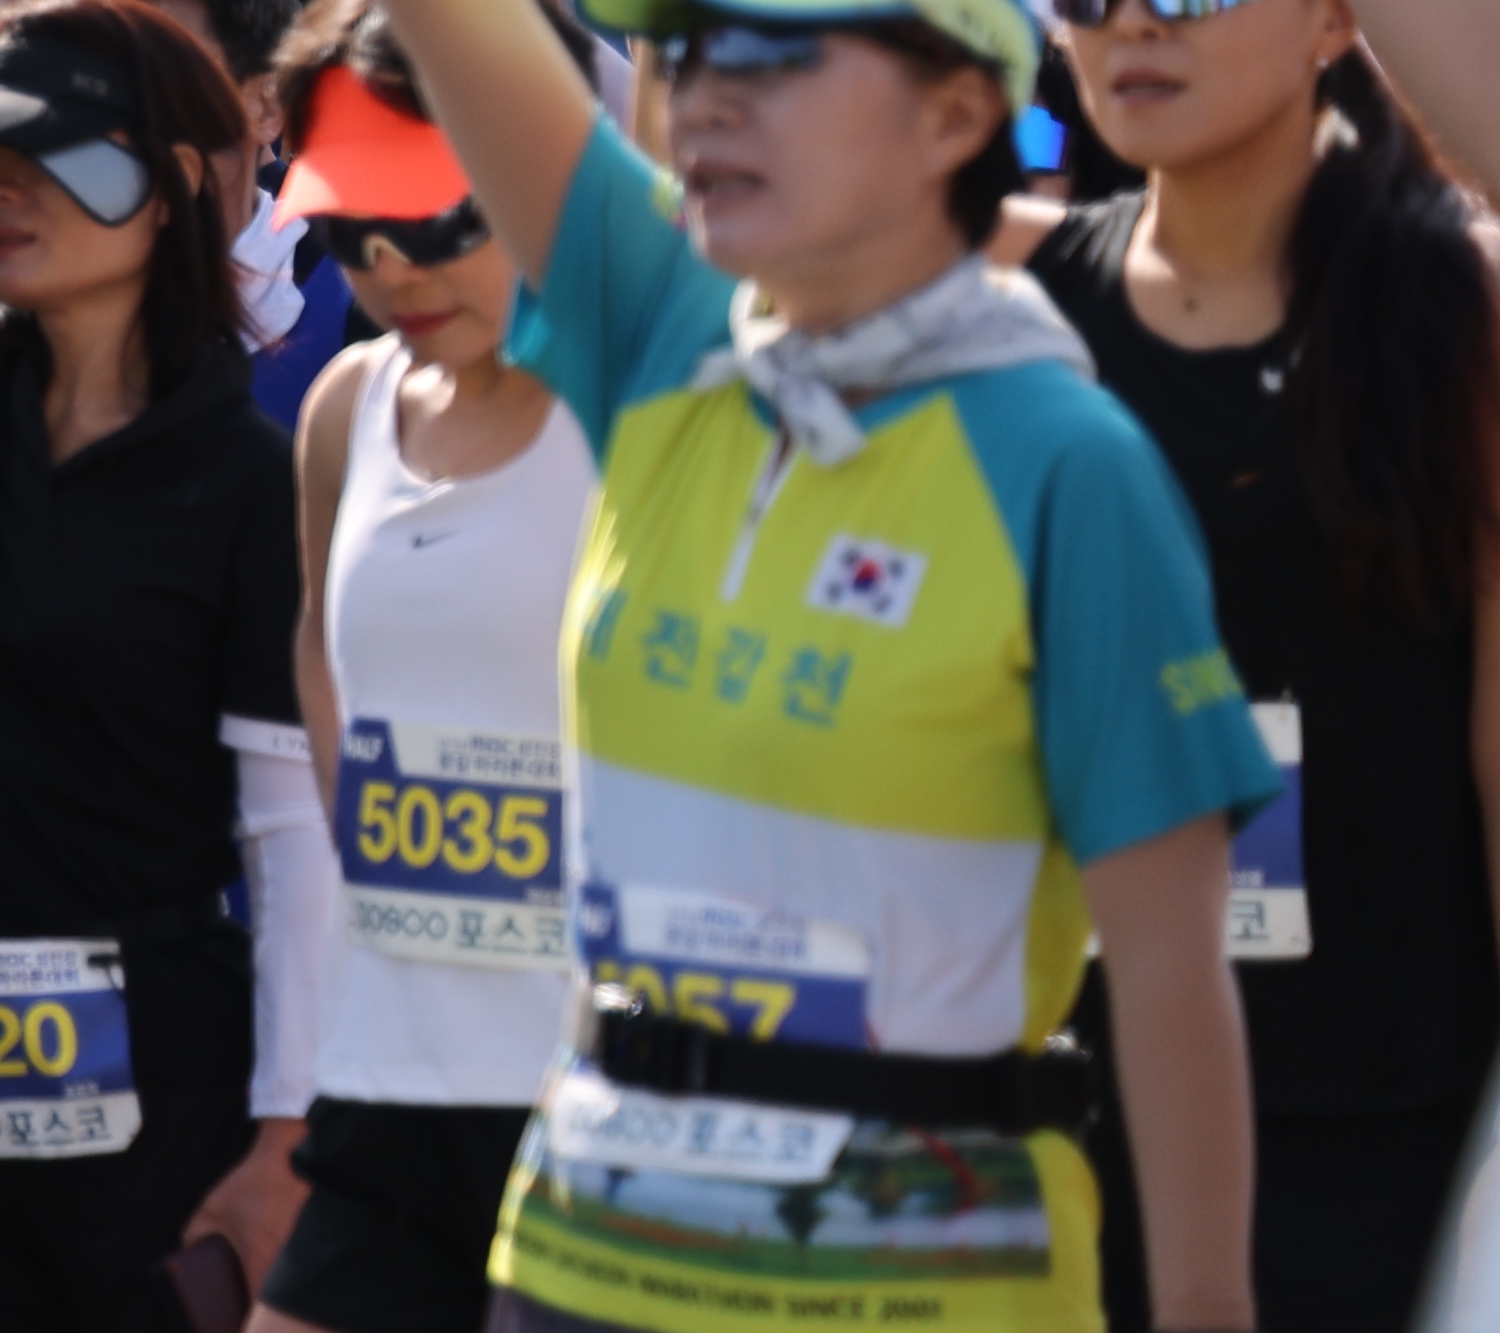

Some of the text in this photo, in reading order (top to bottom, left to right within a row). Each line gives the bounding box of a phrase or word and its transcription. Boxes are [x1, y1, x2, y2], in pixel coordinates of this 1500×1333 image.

[357, 783, 550, 879] 5035
[456, 908, 566, 957] 포스코
[8, 1106, 112, 1146] 포스코
